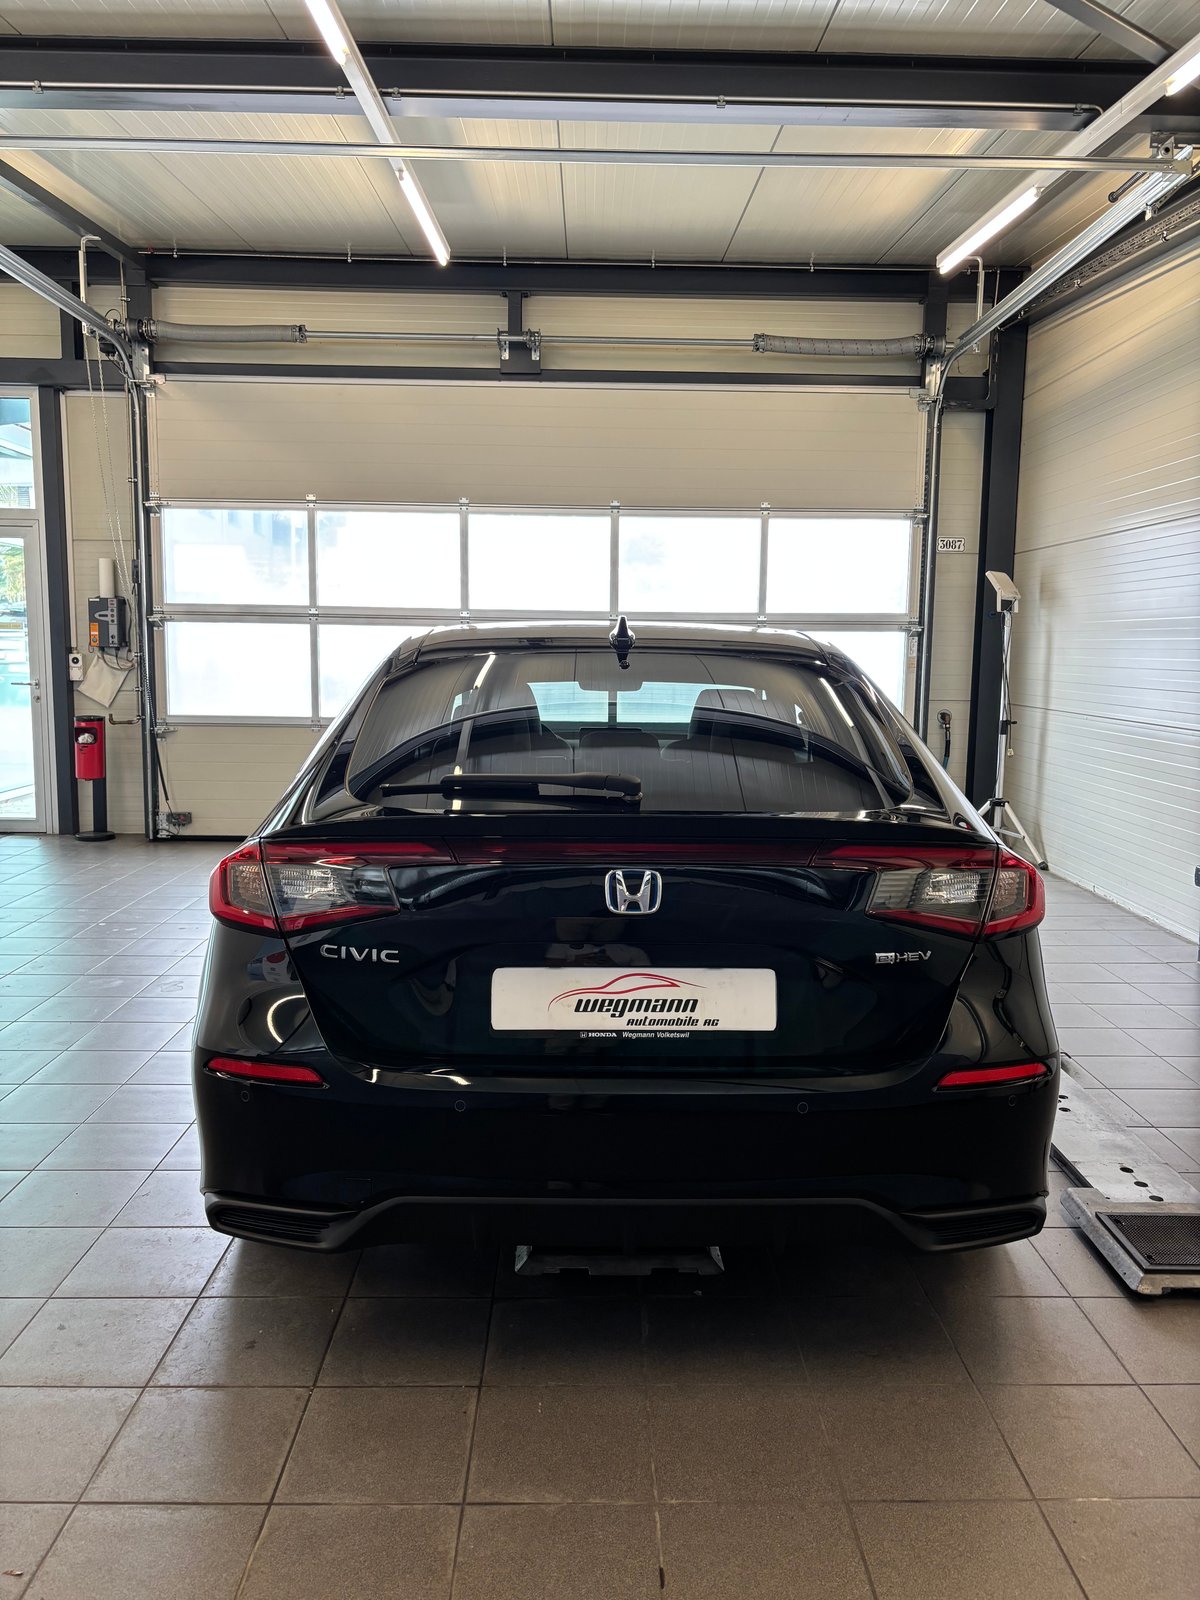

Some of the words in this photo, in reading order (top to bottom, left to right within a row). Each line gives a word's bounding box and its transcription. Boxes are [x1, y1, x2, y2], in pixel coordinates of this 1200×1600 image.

[939, 539, 963, 550] 3087
[320, 944, 400, 963] CIVIC
[574, 998, 699, 1018] wegmann
[702, 1018, 720, 1027] AG
[622, 1031, 655, 1039] Wegmann
[656, 1031, 690, 1039] Volketswil
